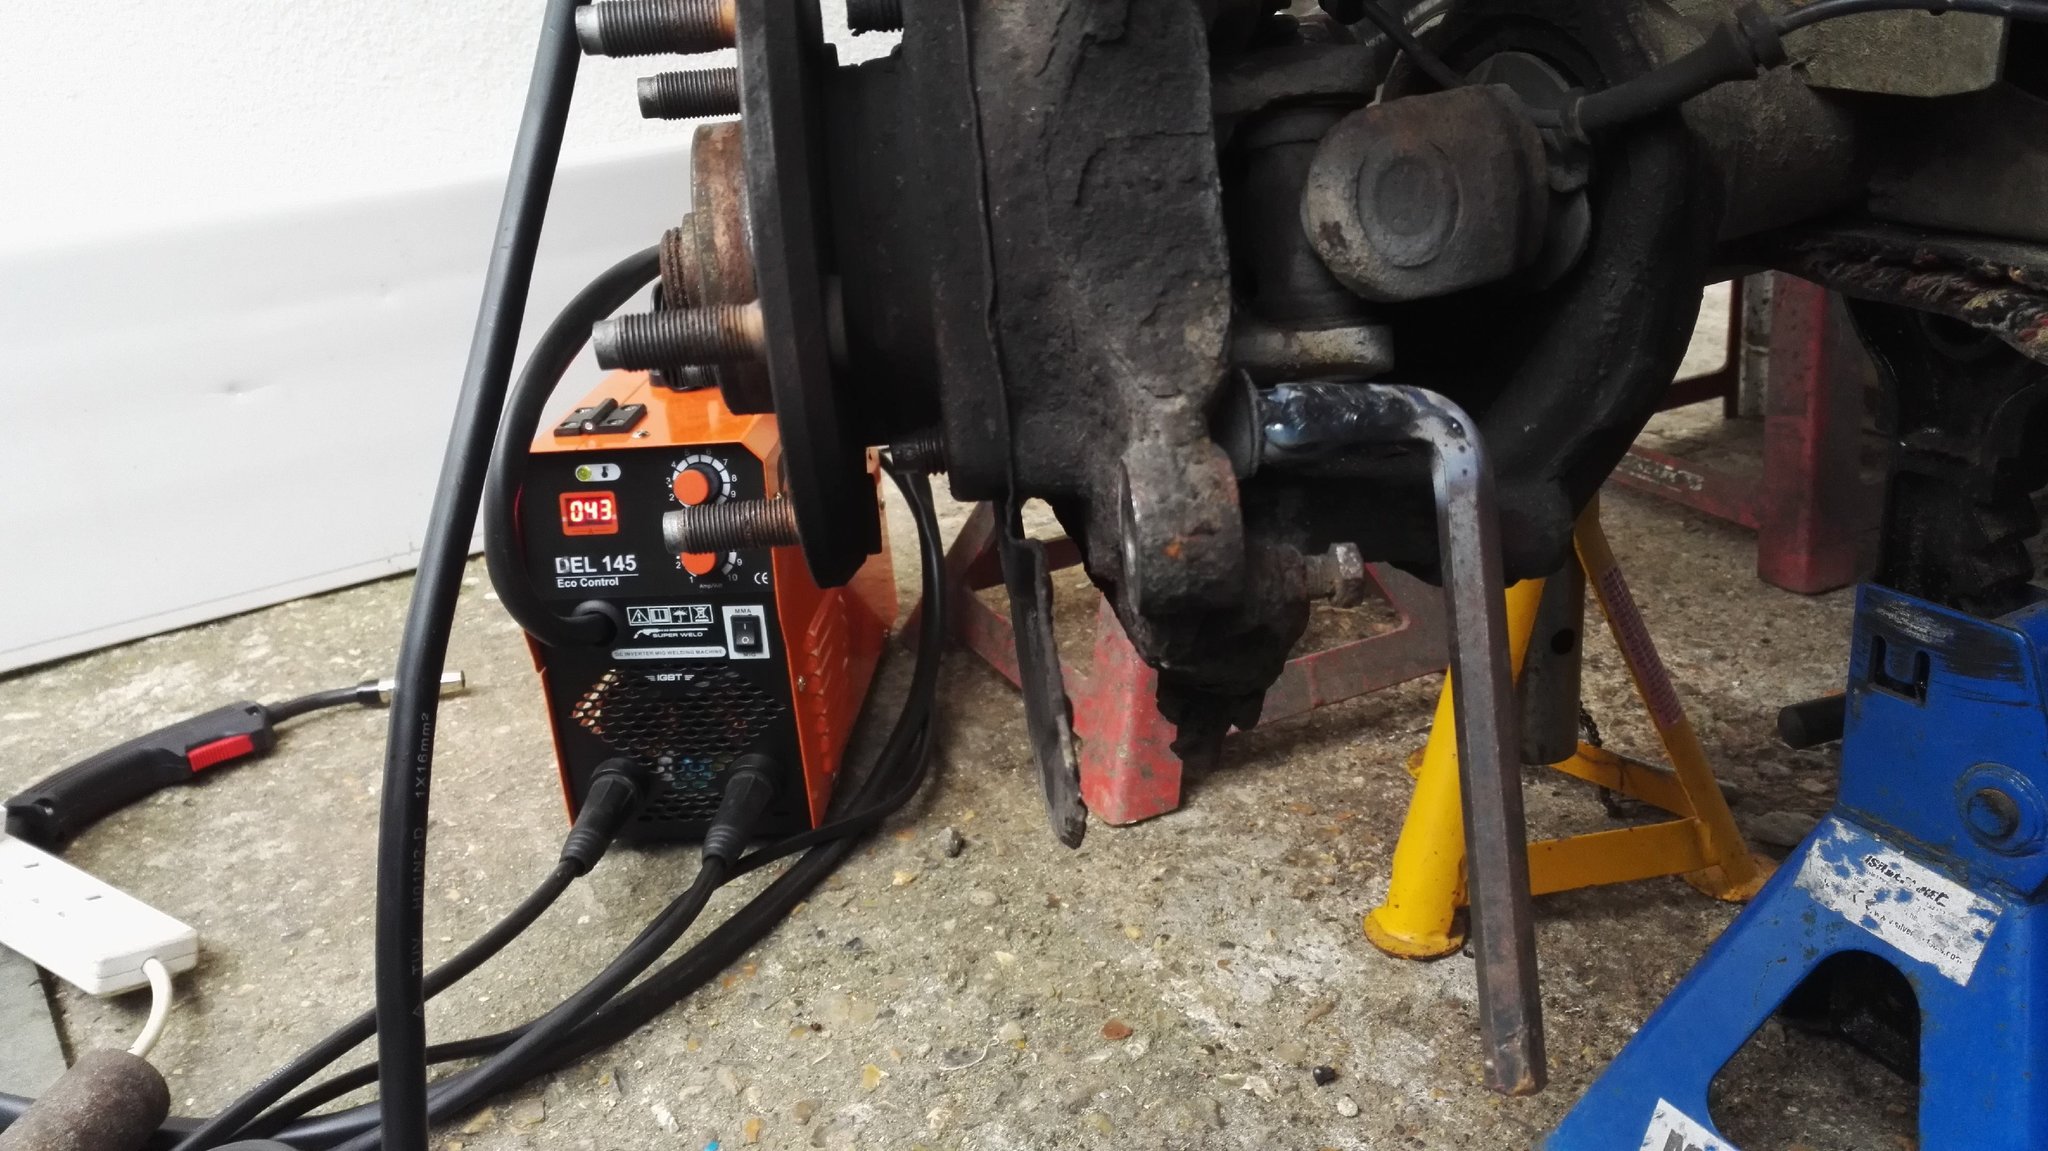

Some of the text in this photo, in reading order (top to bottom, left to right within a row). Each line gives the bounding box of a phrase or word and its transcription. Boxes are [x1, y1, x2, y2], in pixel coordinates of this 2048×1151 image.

[722, 458, 729, 466] 7
[665, 477, 671, 485] 3
[731, 474, 738, 482] 8
[730, 490, 737, 498] 9
[570, 499, 612, 522] 043
[555, 554, 637, 574] DEL 145
[675, 561, 681, 569] 2
[736, 558, 743, 567] 9
[728, 573, 738, 581] 10
[557, 577, 619, 588] Eco Control
[657, 673, 683, 681] IGBT
